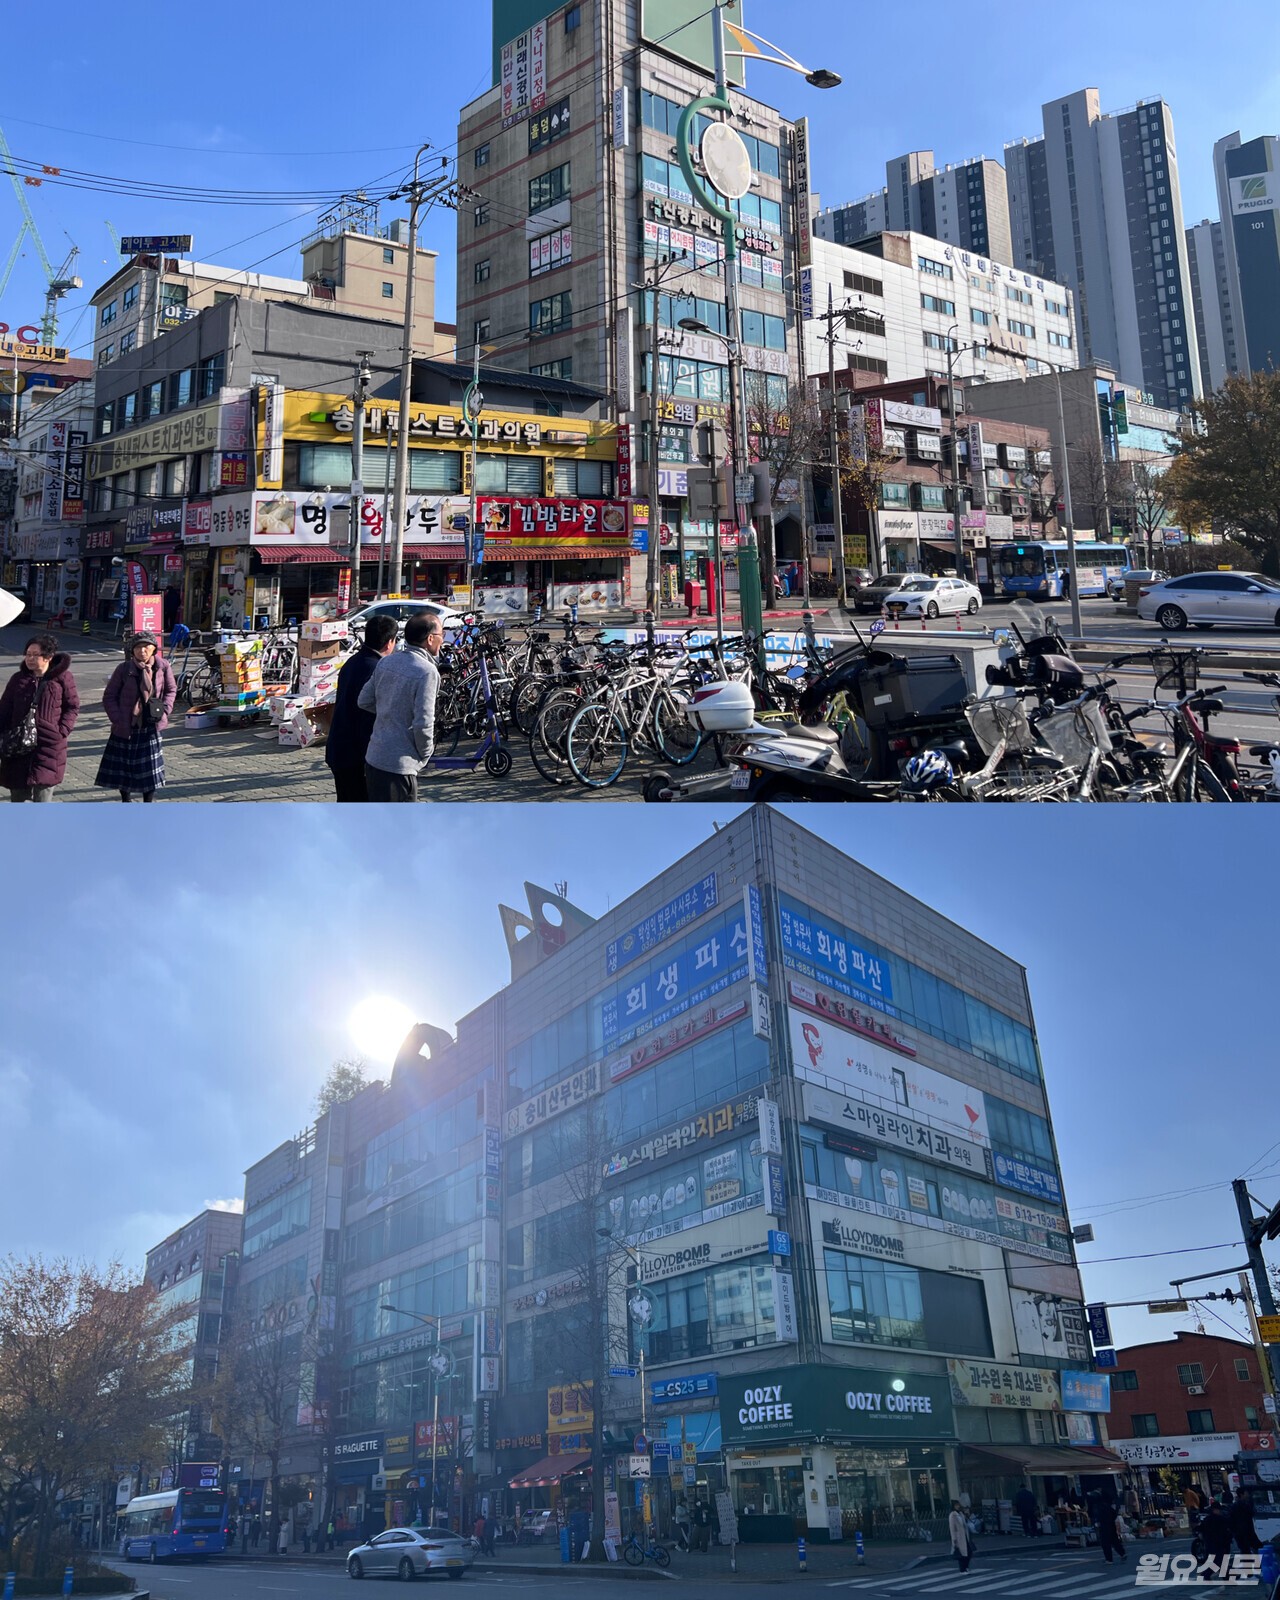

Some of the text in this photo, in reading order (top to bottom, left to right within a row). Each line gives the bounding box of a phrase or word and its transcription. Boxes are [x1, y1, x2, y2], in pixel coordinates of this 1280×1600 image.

[516, 35, 529, 109] 미래신경과
[532, 25, 544, 94] 추나교정
[530, 117, 549, 140] 홀덤
[1238, 198, 1274, 209] PRUGIO
[1251, 222, 1265, 230] 101
[532, 232, 571, 261] 피부성형
[222, 462, 232, 482] 커피
[213, 504, 250, 533] 명동왕만두
[519, 504, 598, 533] 김밥타운
[702, 875, 716, 908] 파산
[608, 941, 618, 971] 회생
[816, 930, 883, 992] 회생 파산
[626, 961, 679, 1016] 회생
[758, 992, 770, 1036] 치과
[628, 1103, 736, 1169] 스마일라인치과
[842, 1102, 973, 1167] 스마일라인치과 의원
[771, 1165, 784, 1207] 부동산
[776, 1232, 787, 1242] GS
[840, 1224, 904, 1252] LLOYDBOMB
[644, 1243, 711, 1273] LLOYDBOMB
[1091, 1308, 1106, 1339] 부동산
[667, 1379, 695, 1396] GS25
[969, 1366, 1001, 1389] 과수원
[1014, 1370, 1044, 1393] 채소밭
[744, 1384, 783, 1406] OOZY
[845, 1391, 933, 1414] OOZY COFFEE
[738, 1402, 794, 1425] COFFEE
[342, 1439, 379, 1454] BAGUETTE
